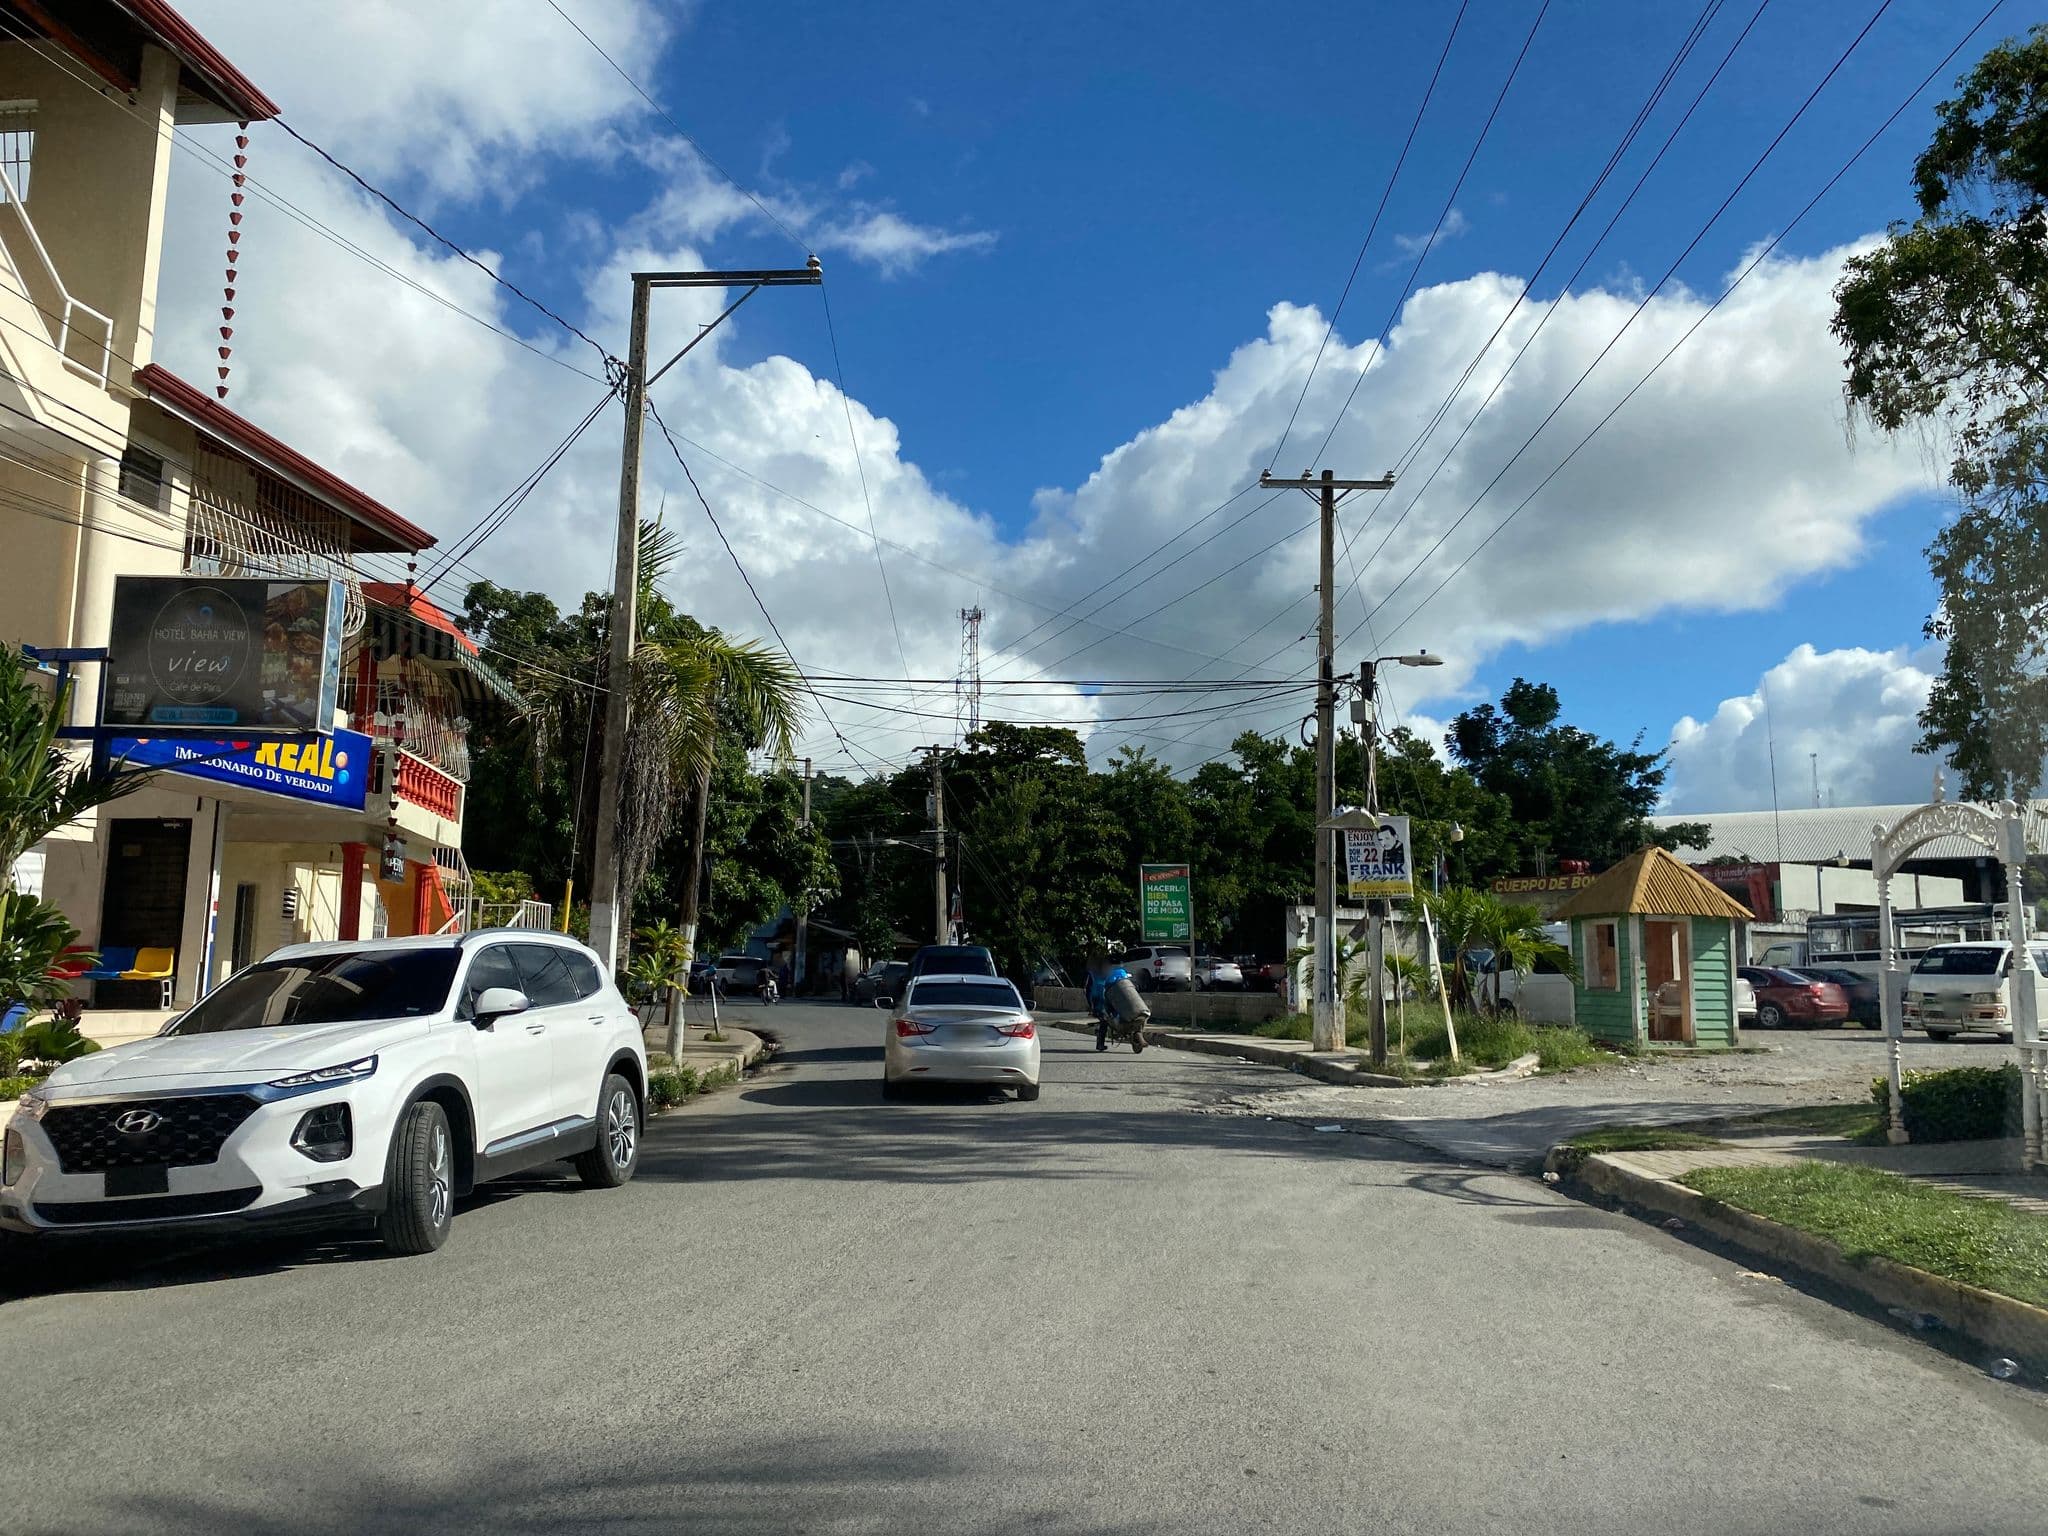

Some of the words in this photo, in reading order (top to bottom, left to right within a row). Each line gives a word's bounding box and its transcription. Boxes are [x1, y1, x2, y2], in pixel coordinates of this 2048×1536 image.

[154, 628, 185, 640] HOTEL
[223, 629, 247, 641] VIEW
[168, 650, 228, 672] view
[1348, 833, 1374, 841] ENJOY
[1363, 848, 1378, 863] 22
[1350, 863, 1405, 875] FRANK
[1495, 879, 1547, 892] CUERPO
[1548, 877, 1569, 890] DE
[1571, 876, 1597, 889] BO
[1147, 892, 1169, 900] BIEN
